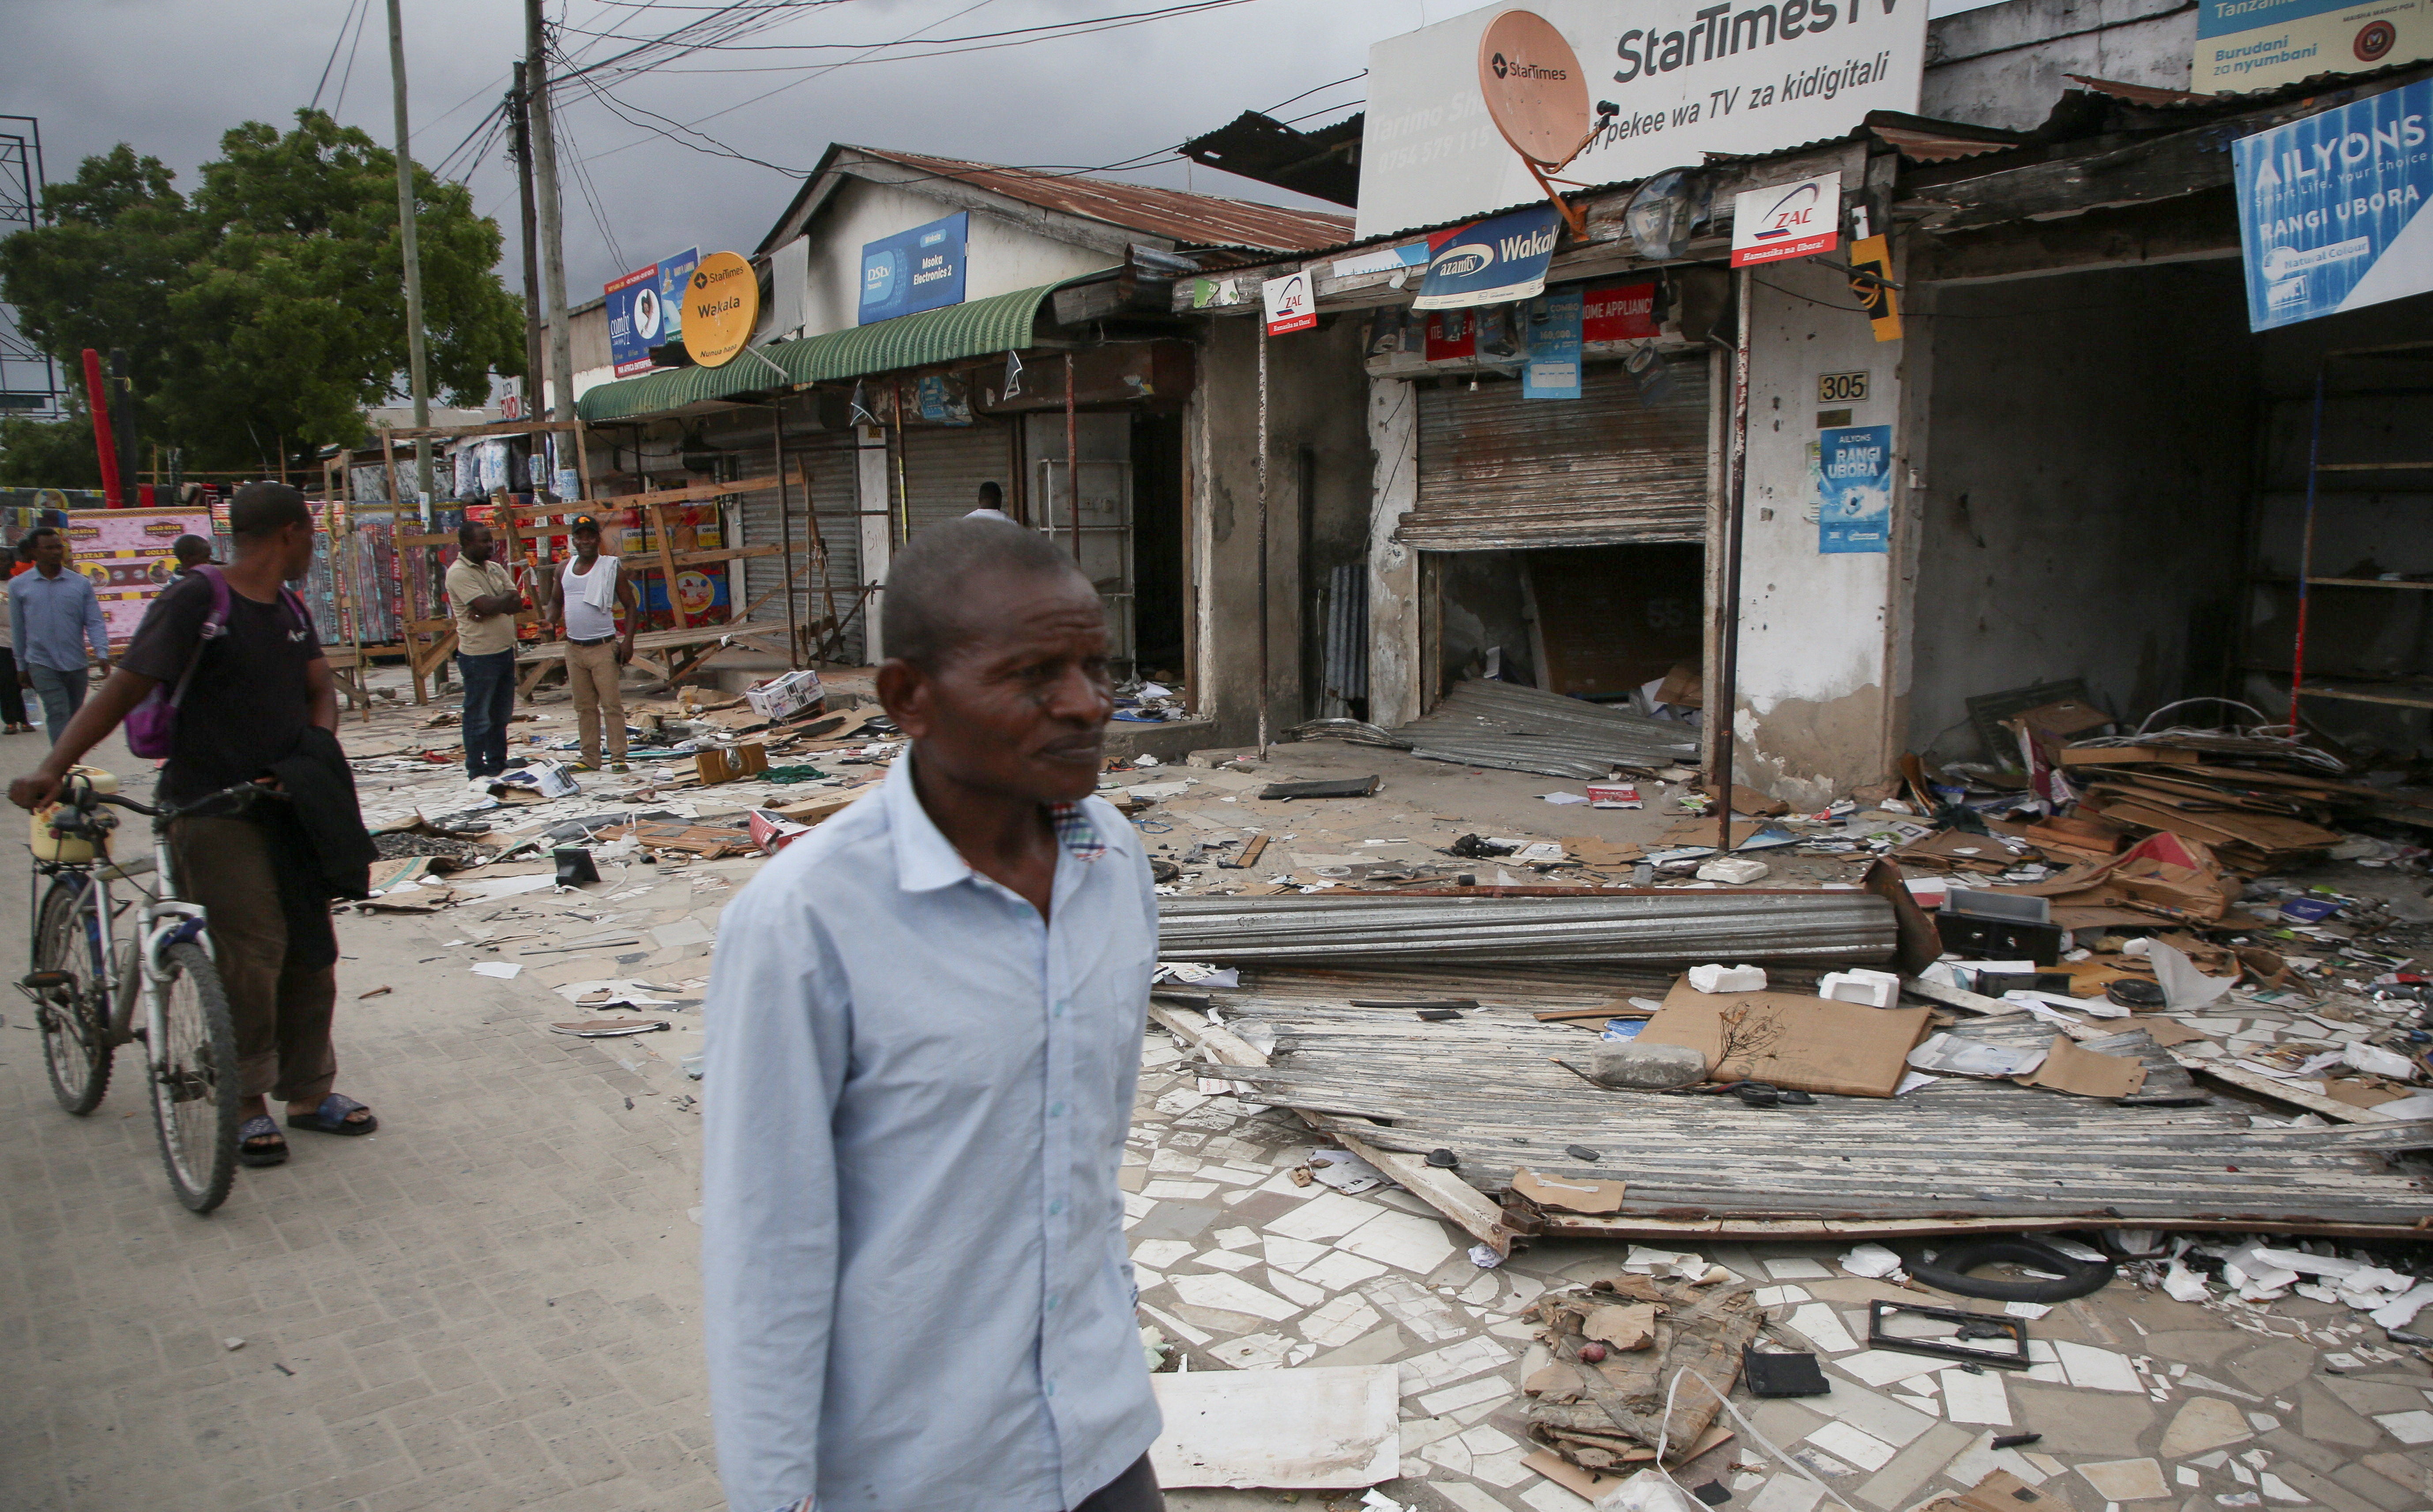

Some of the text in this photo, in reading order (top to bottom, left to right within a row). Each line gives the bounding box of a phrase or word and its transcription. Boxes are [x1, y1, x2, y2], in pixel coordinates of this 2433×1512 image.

[1613, 0, 1838, 83] StarTimes
[2215, 34, 2290, 62] Burudani
[2214, 43, 2318, 75] za nyumbani
[1510, 61, 1567, 80] StarTimes
[1604, 111, 1665, 151] pekee
[1673, 102, 1701, 128] wa
[1709, 86, 1740, 119] TV
[1748, 85, 1775, 110] za
[1781, 50, 1891, 103] kidigitali
[2255, 114, 2426, 185] AILYONS
[2338, 168, 2370, 184] Your
[2378, 152, 2428, 173] Choice
[1775, 208, 1813, 229] ZAC
[2260, 184, 2420, 241] RANGI UBORA
[2329, 241, 2367, 258] Colour
[922, 254, 944, 270] Msoka
[710, 266, 744, 283] StarTimes
[867, 265, 892, 281] DStv
[913, 264, 952, 285] Electronics 2
[697, 295, 741, 319] Wakala
[1286, 294, 1303, 308] ZAC
[700, 343, 737, 358] Nunua hapa
[1823, 374, 1867, 401] 305
[1838, 434, 1872, 443] AILYONS
[1835, 446, 1882, 464] RANGI
[1827, 462, 1879, 479] UBORA
